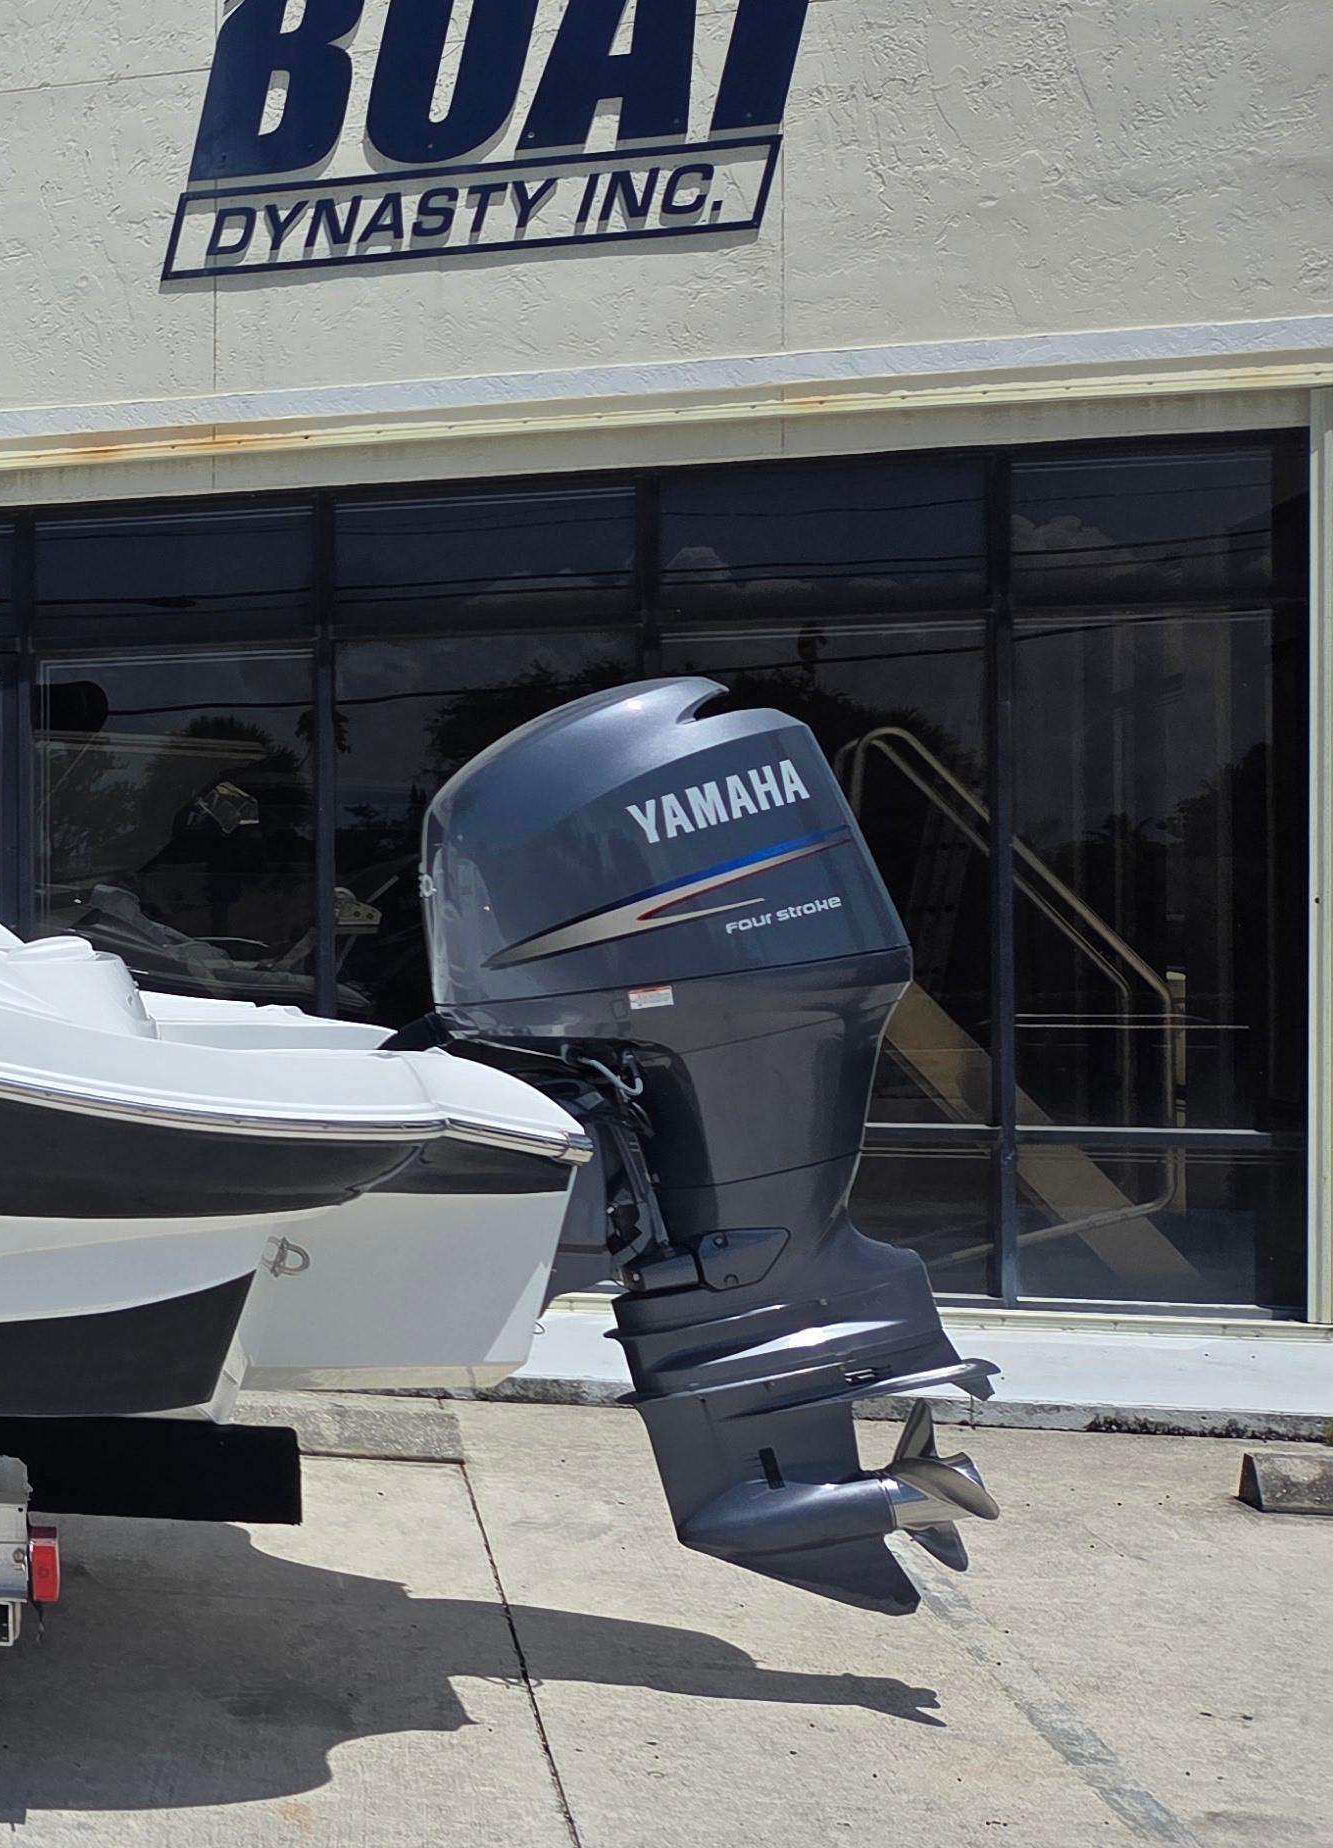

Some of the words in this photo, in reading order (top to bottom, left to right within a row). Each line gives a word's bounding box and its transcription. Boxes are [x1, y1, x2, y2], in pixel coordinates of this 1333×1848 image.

[206, 178, 556, 257] DYNASTY
[576, 163, 724, 224] INC.
[626, 759, 811, 843] YAMAHA
